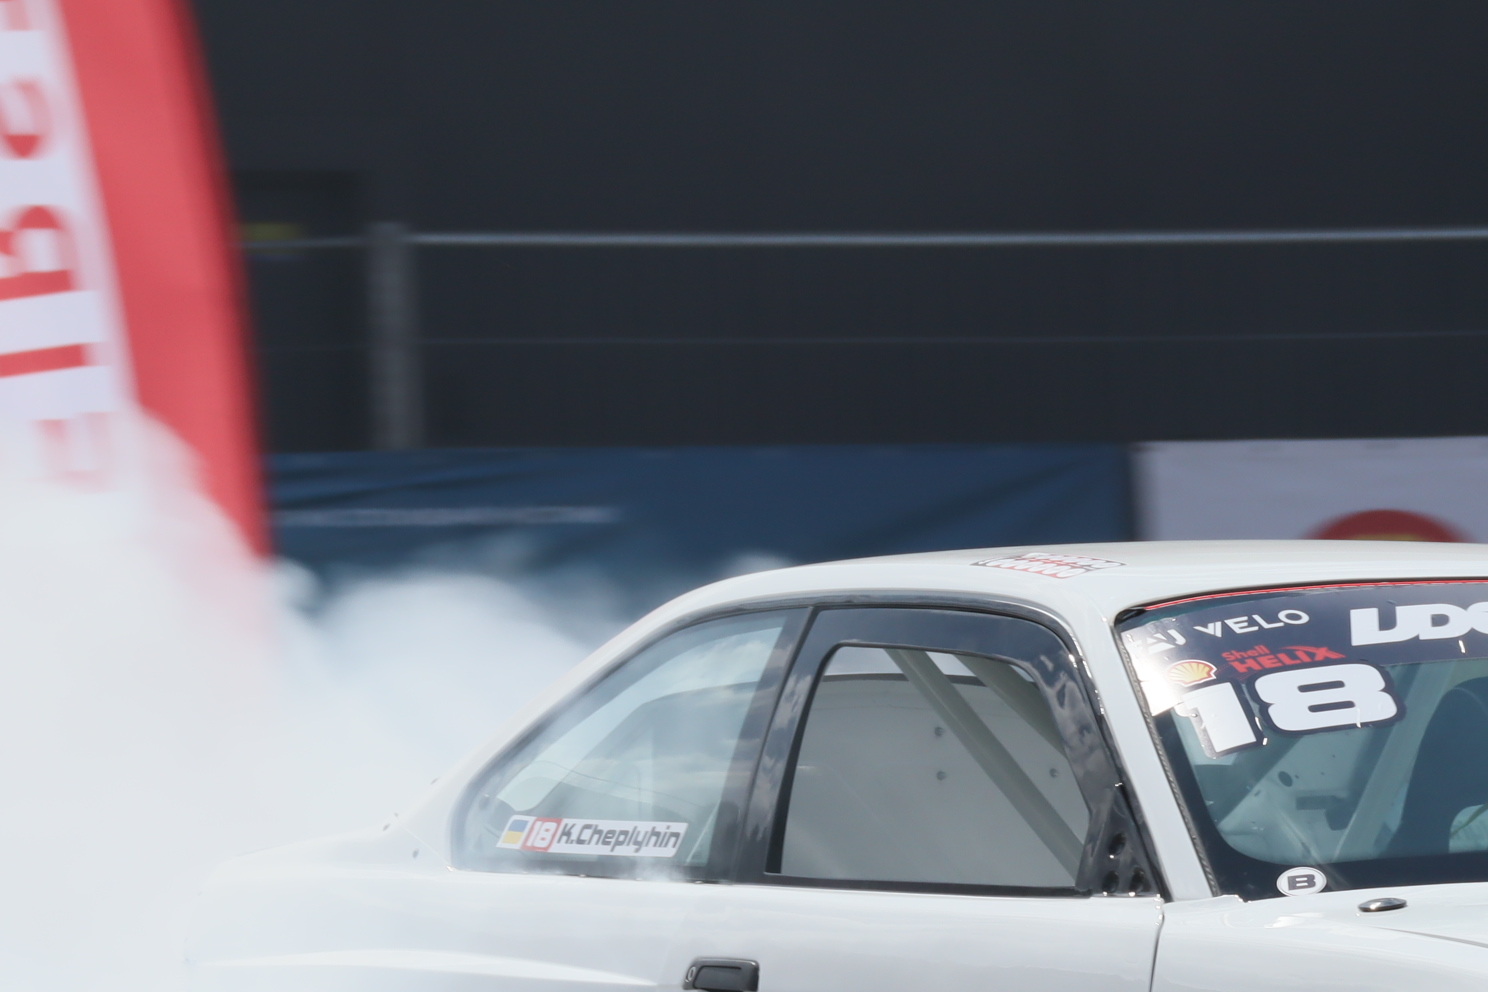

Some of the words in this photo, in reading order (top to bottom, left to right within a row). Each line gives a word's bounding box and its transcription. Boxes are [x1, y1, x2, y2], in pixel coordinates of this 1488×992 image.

[1193, 609, 1309, 638] VELO
[1221, 645, 1271, 661] Shell
[1229, 646, 1345, 673] HELIX
[1176, 663, 1398, 753] 18
[525, 821, 557, 849] 18
